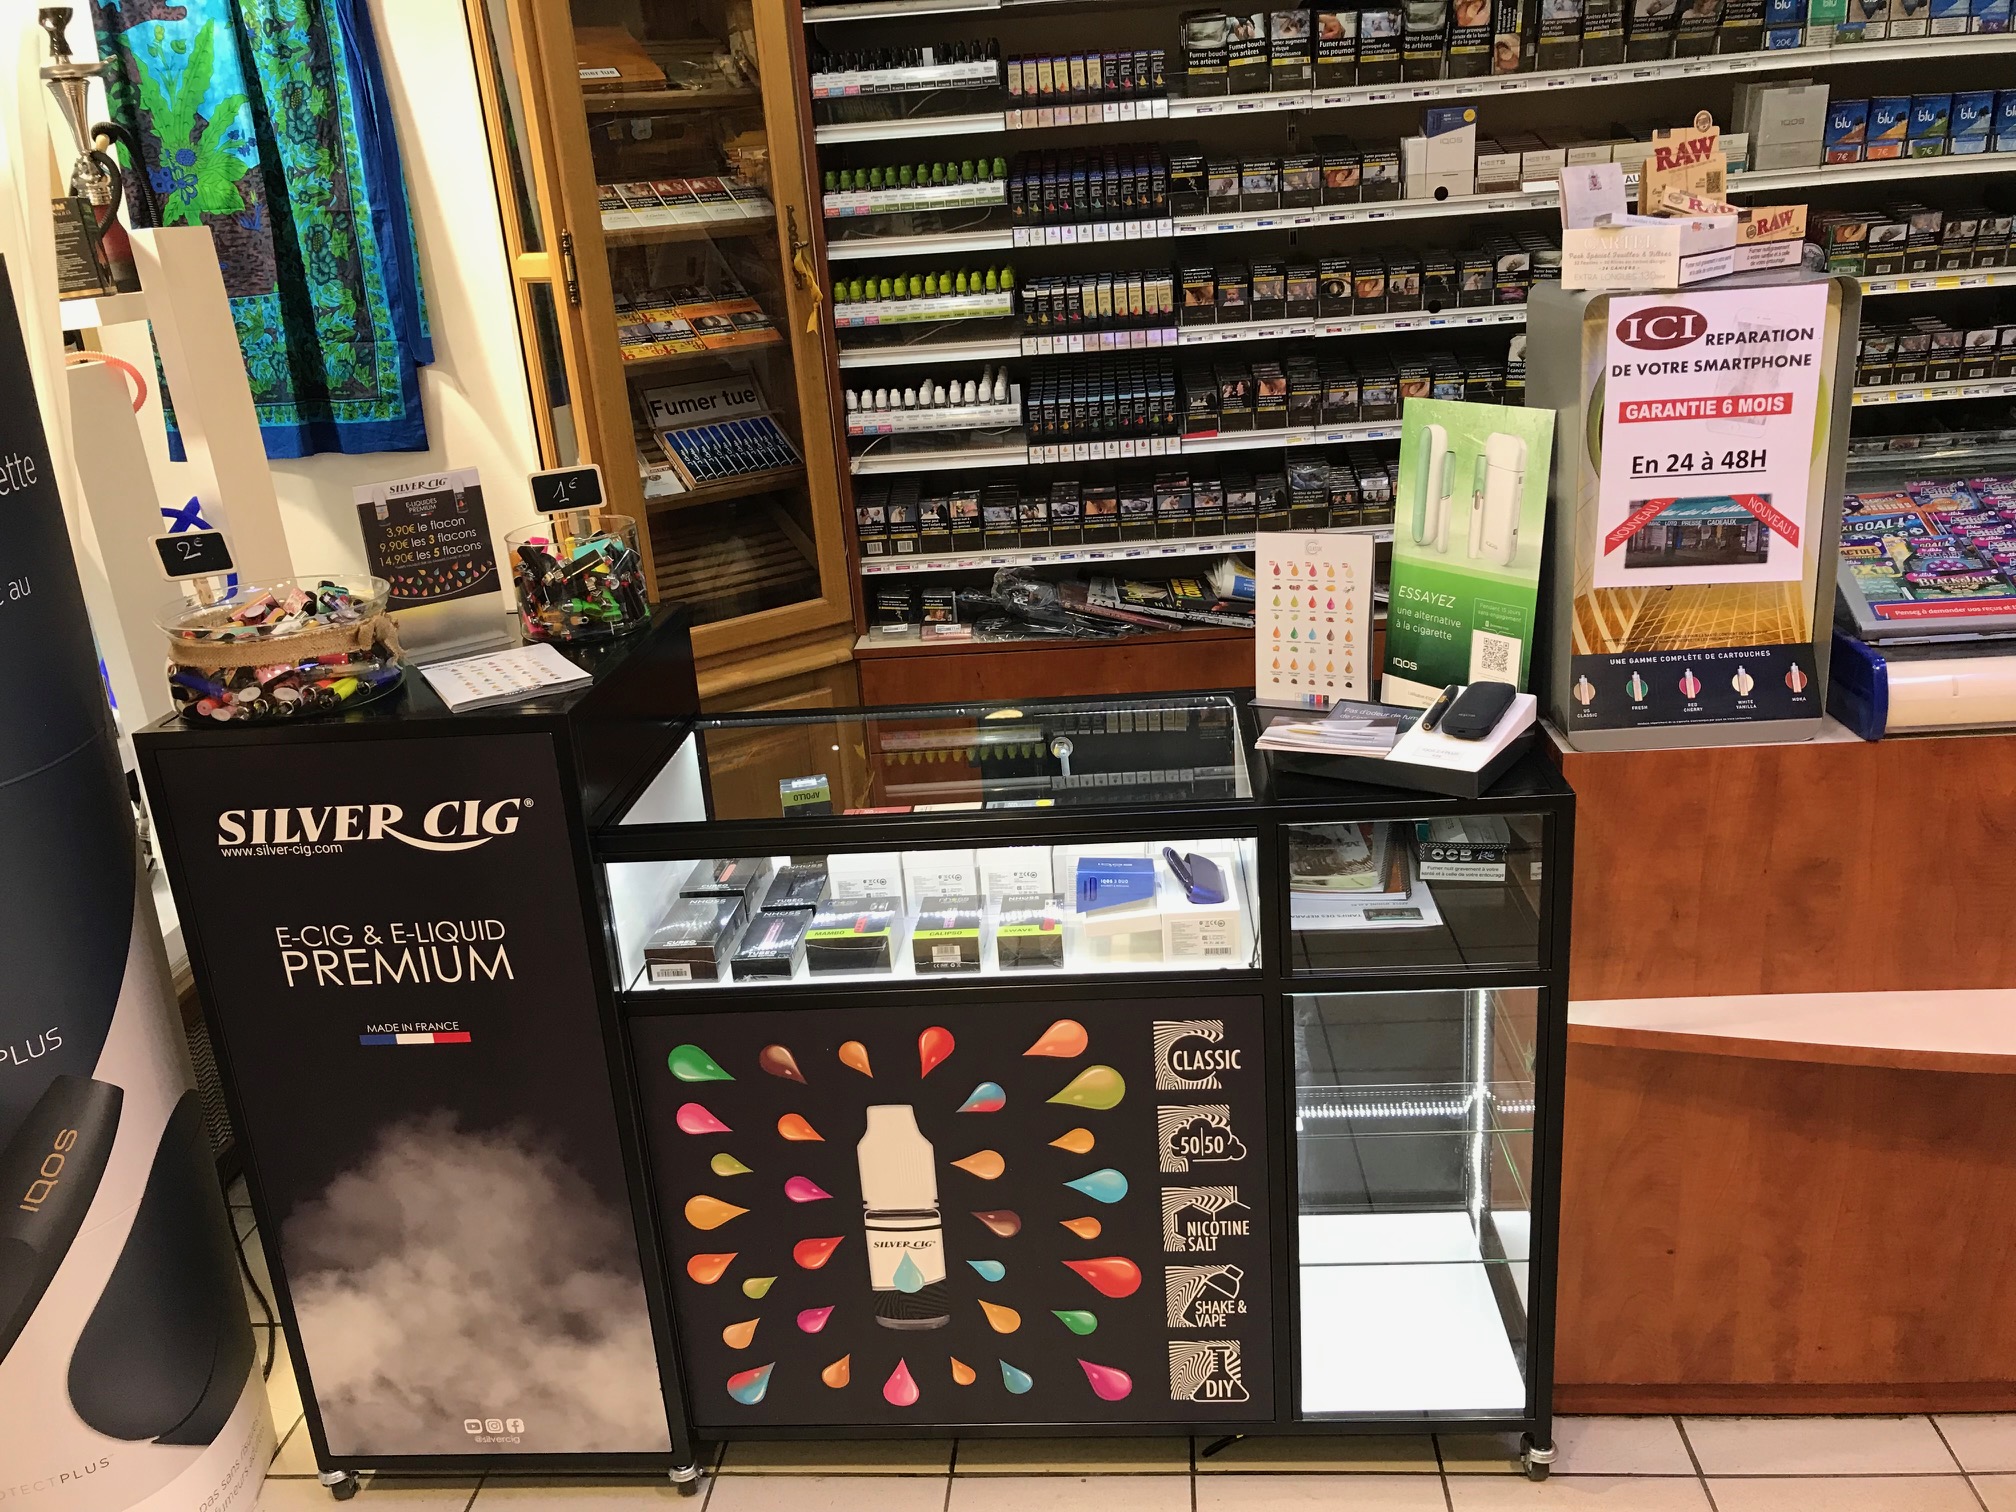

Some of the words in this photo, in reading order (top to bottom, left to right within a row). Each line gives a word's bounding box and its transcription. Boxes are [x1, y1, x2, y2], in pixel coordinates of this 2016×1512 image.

[1775, 36, 1792, 47] 20€
[1845, 31, 1856, 40] 7€
[1319, 40, 1338, 48] Fumer
[1877, 111, 1894, 124] blu
[1918, 110, 1935, 122] blu
[1960, 108, 1977, 120] blu
[1834, 116, 1851, 129] blu
[1439, 136, 1463, 145] IQOS
[1654, 135, 1717, 173] RAW
[1836, 151, 1848, 161] 7€
[1922, 146, 1933, 156] 7€
[1480, 159, 1506, 167] HEETS
[1756, 208, 1796, 236] RAW
[1583, 234, 1658, 250] CARTEL
[1624, 314, 1698, 343] ICI
[1705, 327, 1815, 346] REPARATION
[1612, 364, 1631, 377] DE
[1637, 361, 1689, 376] VOTRE
[1693, 353, 1812, 373] SMARTPHONE
[649, 393, 718, 419] Fumer
[721, 388, 757, 408] tue
[1625, 399, 1717, 420] GARANTIE
[1722, 399, 1733, 414] 6
[1738, 396, 1785, 414] MOIS
[1632, 455, 1659, 475] En
[1666, 453, 1694, 472] 24
[1701, 449, 1713, 471] à
[1720, 449, 1767, 470] 48H
[388, 480, 427, 495] SILVER
[426, 476, 449, 490] CIG
[552, 476, 579, 503] 1€
[404, 497, 438, 509] E-LIQUIDES
[407, 503, 437, 514] PREMIUM
[1609, 504, 1659, 542] NOUVEAU
[1707, 518, 1737, 527] CADEAUX
[1747, 496, 1791, 535] NOUVEAU
[416, 522, 429, 533] le
[429, 516, 466, 531] flacon
[410, 536, 427, 548] les
[428, 534, 436, 545] 3
[436, 527, 478, 544] flacons
[415, 548, 431, 561] les
[433, 546, 441, 558] 5
[8, 576, 32, 600] au
[1397, 585, 1457, 609] ESSAYEZ
[1396, 607, 1412, 617] une
[1413, 609, 1462, 629] alternative
[1395, 619, 1401, 628] à
[1402, 621, 1411, 630] la
[1412, 622, 1453, 641] cigarette
[1392, 656, 1418, 671] IQOS
[1660, 651, 1703, 662] COMPLÈTE
[1717, 650, 1771, 660] CARTOUCHES
[1343, 707, 1359, 716] Pas
[1359, 708, 1391, 719] d'odeur
[793, 791, 821, 802] APOLLO
[217, 803, 404, 847] SILVER
[220, 842, 344, 858] www.silver-cig.com
[1431, 848, 1473, 861] OCB
[788, 863, 824, 871] NHOSS
[275, 924, 354, 948] E-CIG
[363, 923, 384, 946] &
[390, 918, 506, 944] E-LIQUID
[748, 950, 778, 958] TUBEO
[281, 943, 515, 988] PREMIUM
[366, 1023, 400, 1033] MADE
[401, 1022, 413, 1032] IN
[415, 1021, 460, 1031] FRANCE
[1172, 1049, 1242, 1070] CLASSIC
[19, 1128, 79, 1213] IQOS
[1186, 1220, 1250, 1237] NICOTINE
[873, 1241, 911, 1249] SILVER
[1187, 1236, 1218, 1252] SALT
[1195, 1300, 1236, 1314] SHAKE
[1237, 1300, 1247, 1314] &
[1195, 1313, 1227, 1328] VAPE
[1205, 1379, 1235, 1398] DIY
[474, 1434, 521, 1445] @silvercig
[220, 1459, 241, 1491] sans
